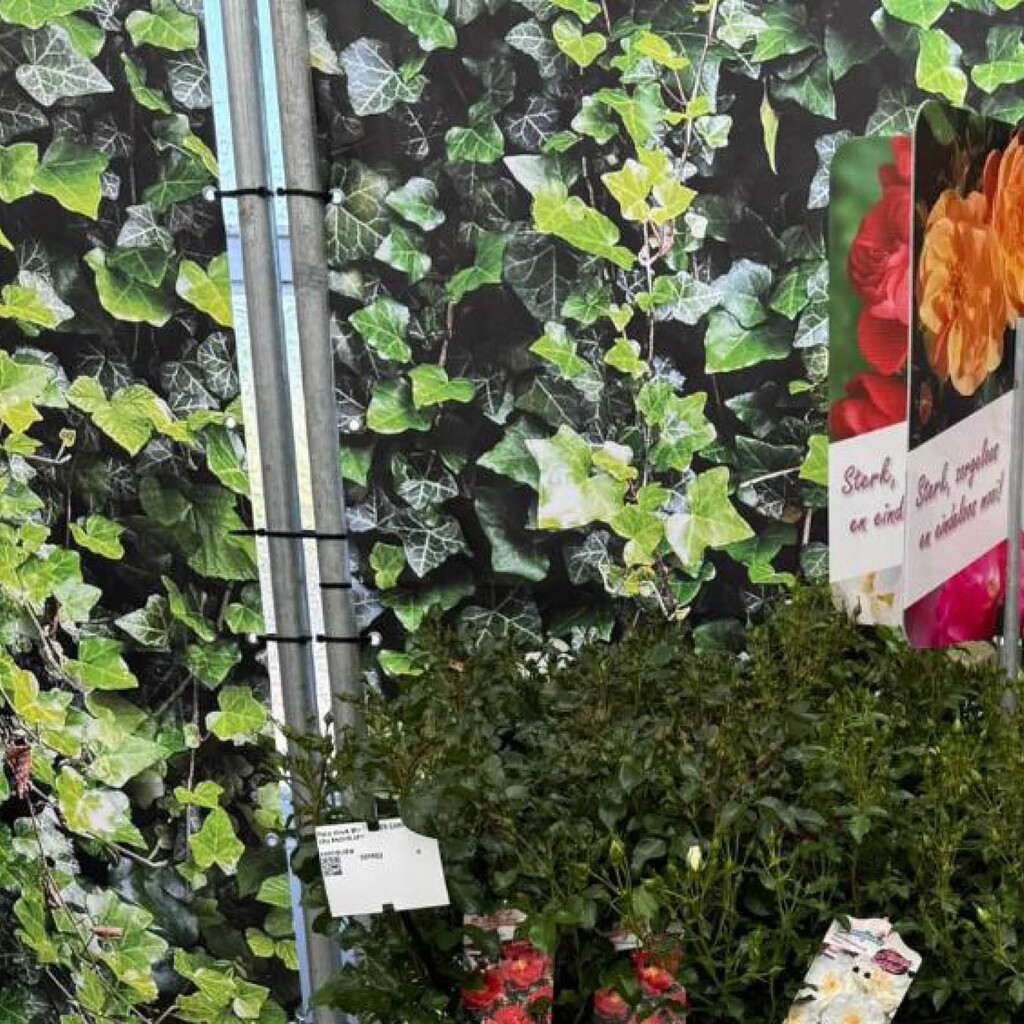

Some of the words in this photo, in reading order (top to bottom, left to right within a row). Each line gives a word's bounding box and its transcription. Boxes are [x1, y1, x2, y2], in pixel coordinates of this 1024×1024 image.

[842, 456, 895, 494] Sterk,
[916, 461, 950, 507] Sterk,
[955, 437, 999, 488] zorgeloos
[850, 517, 866, 533] en
[919, 531, 932, 550] en
